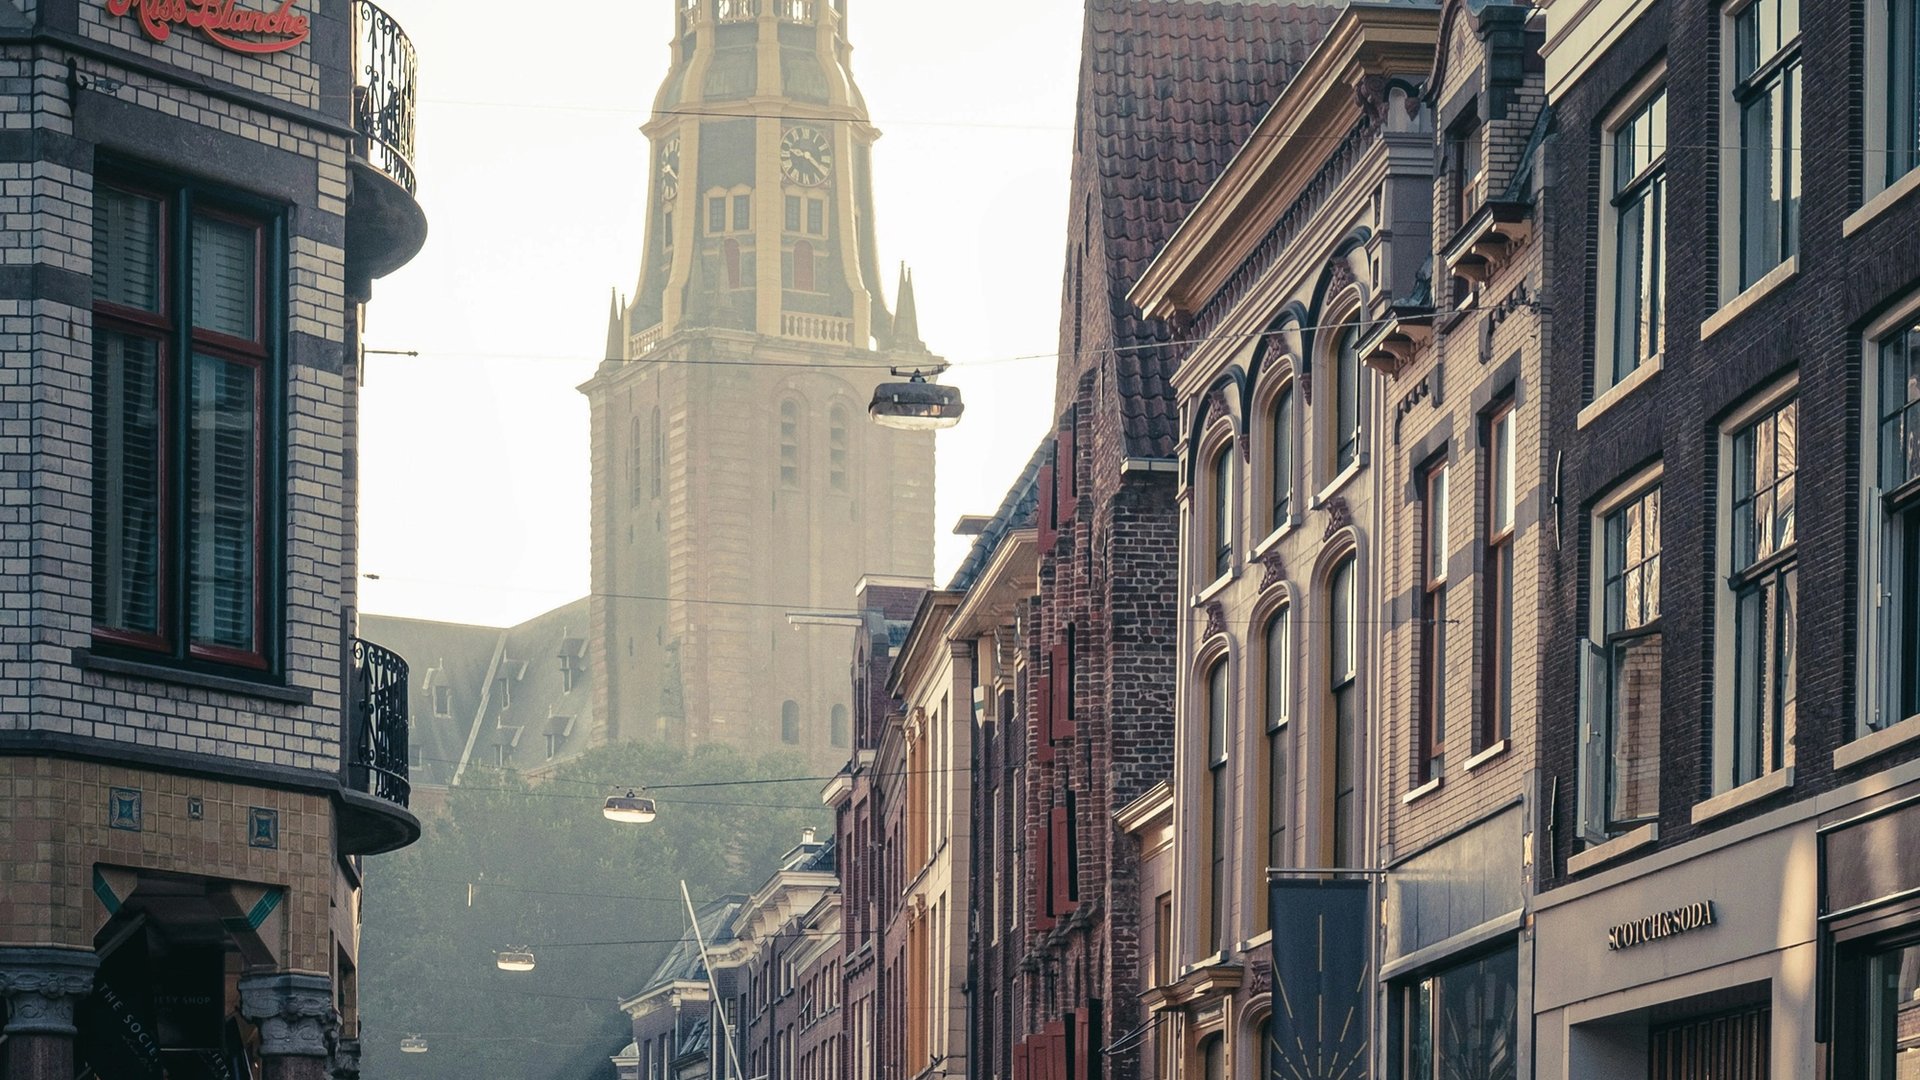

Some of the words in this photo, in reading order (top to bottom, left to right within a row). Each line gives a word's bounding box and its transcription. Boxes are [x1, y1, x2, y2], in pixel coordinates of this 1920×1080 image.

[187, 0, 309, 53] Blanche
[1608, 900, 1716, 951] SCOTCH&SODA
[100, 982, 123, 1011] THE
[123, 1014, 158, 1062] SOCIE
